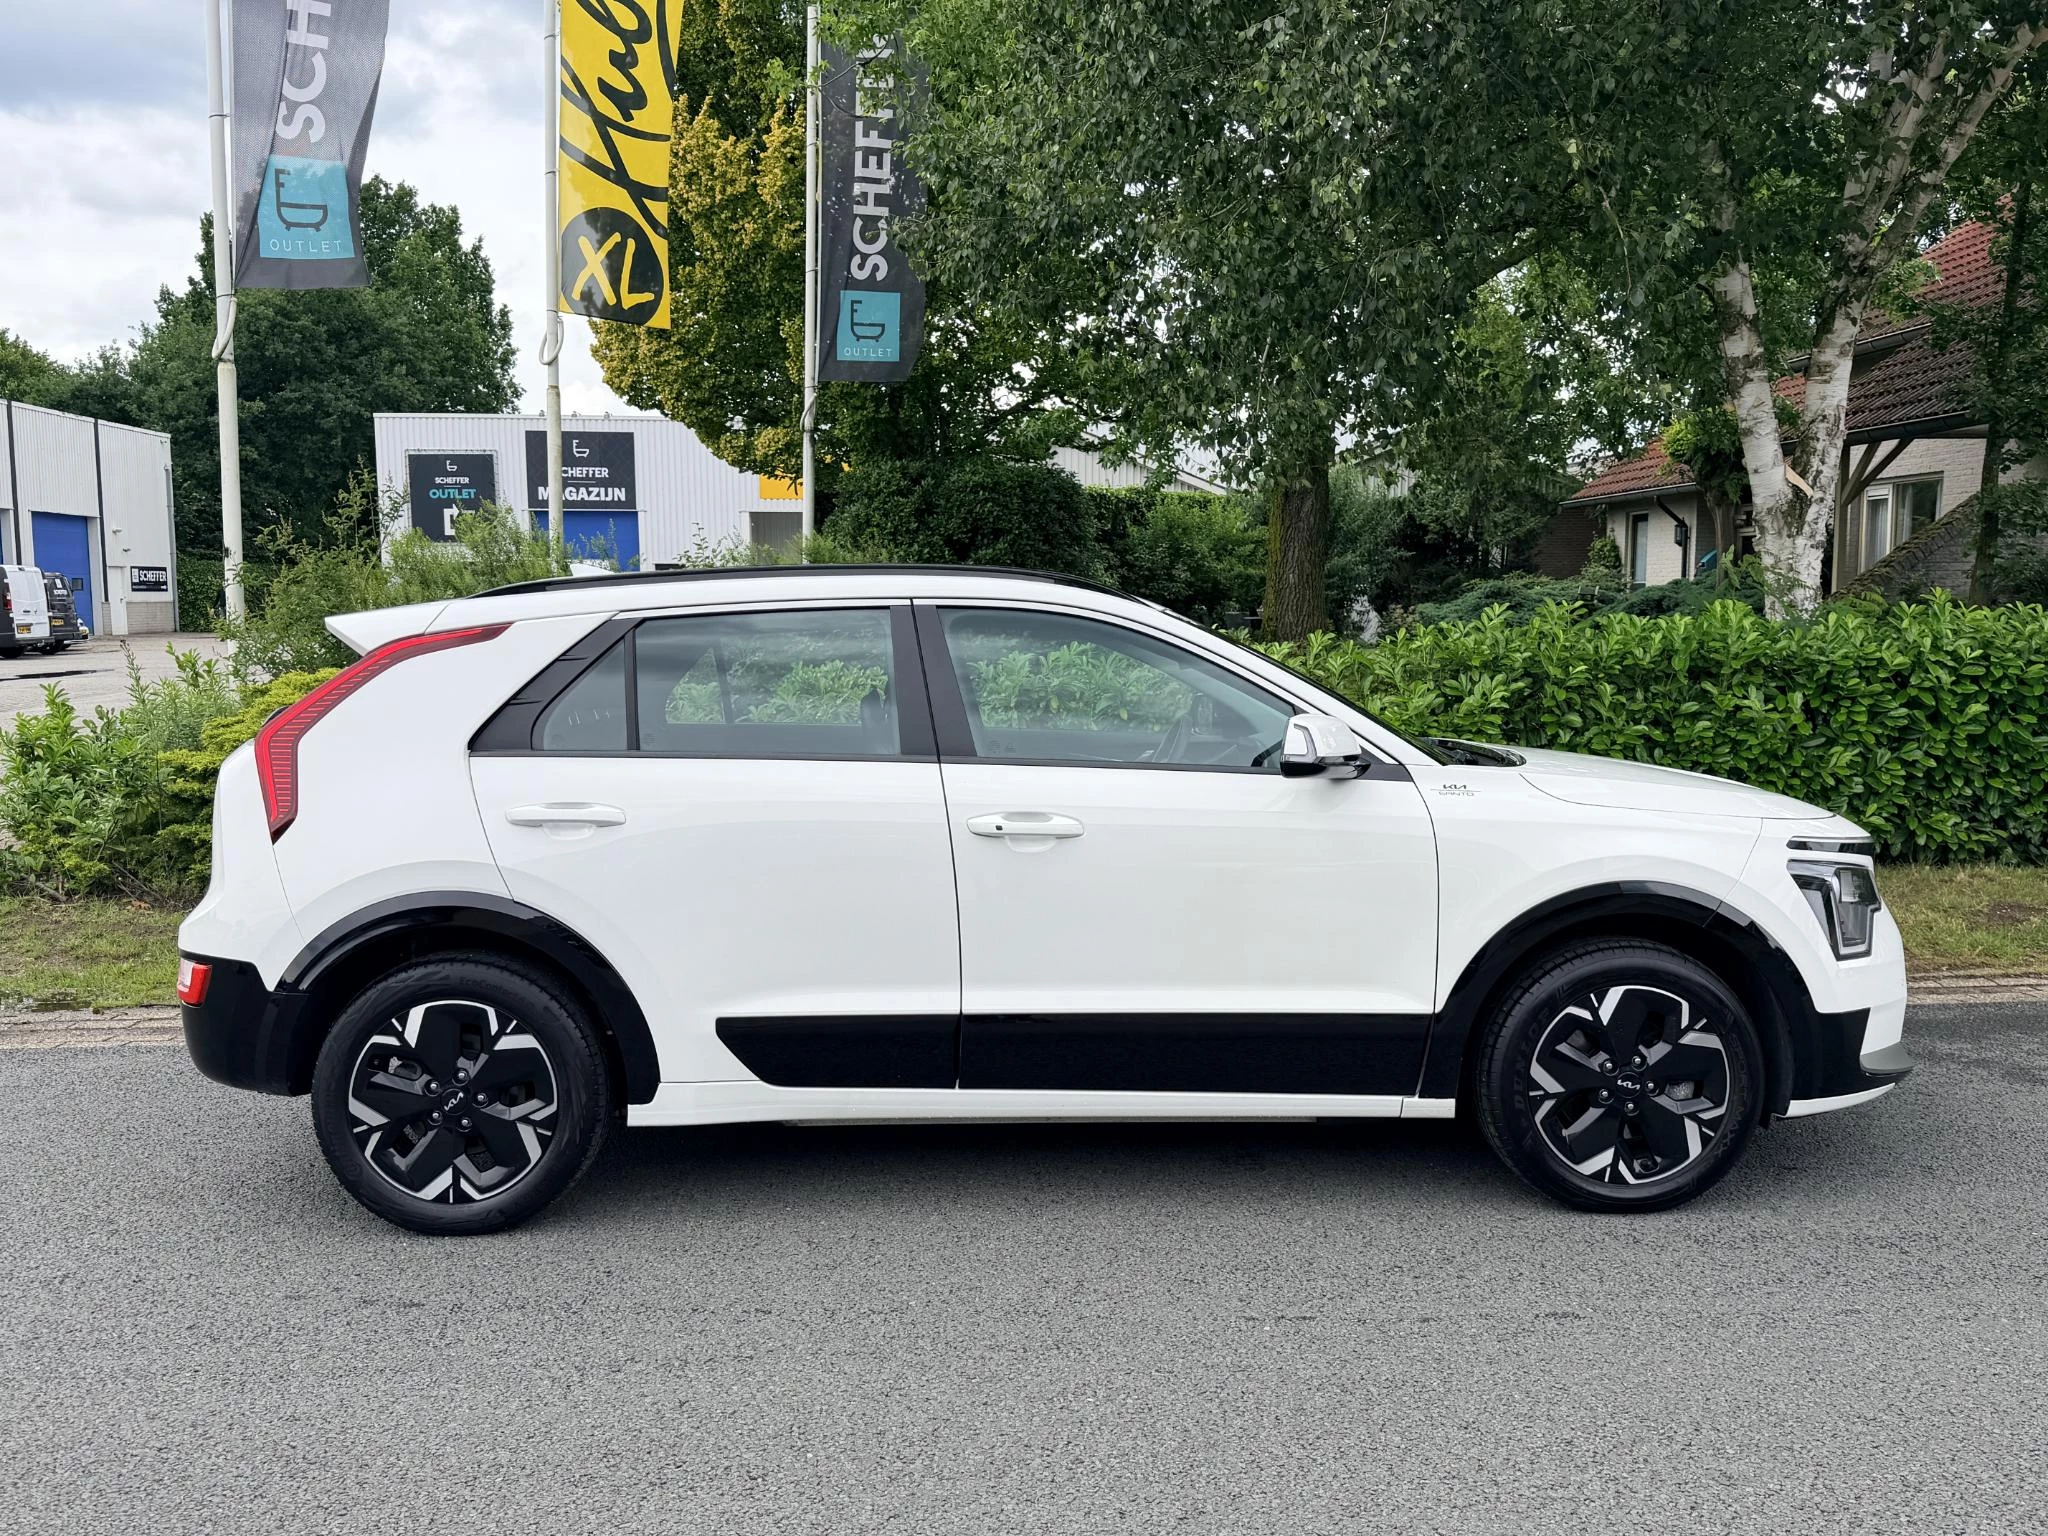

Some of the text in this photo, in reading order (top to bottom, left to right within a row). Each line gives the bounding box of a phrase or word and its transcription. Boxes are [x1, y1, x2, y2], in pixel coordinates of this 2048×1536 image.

[270, 239, 342, 252] OUTLET
[571, 232, 655, 310] XL
[843, 346, 892, 357] OUTLET
[560, 466, 609, 478] CHEFFER
[434, 476, 470, 484] SCHEFFER
[429, 488, 477, 499] OUTLET
[537, 486, 626, 502] MGAZIJN
[139, 570, 167, 582] SCHEFFER
[1713, 1105, 1744, 1158] MAXX
